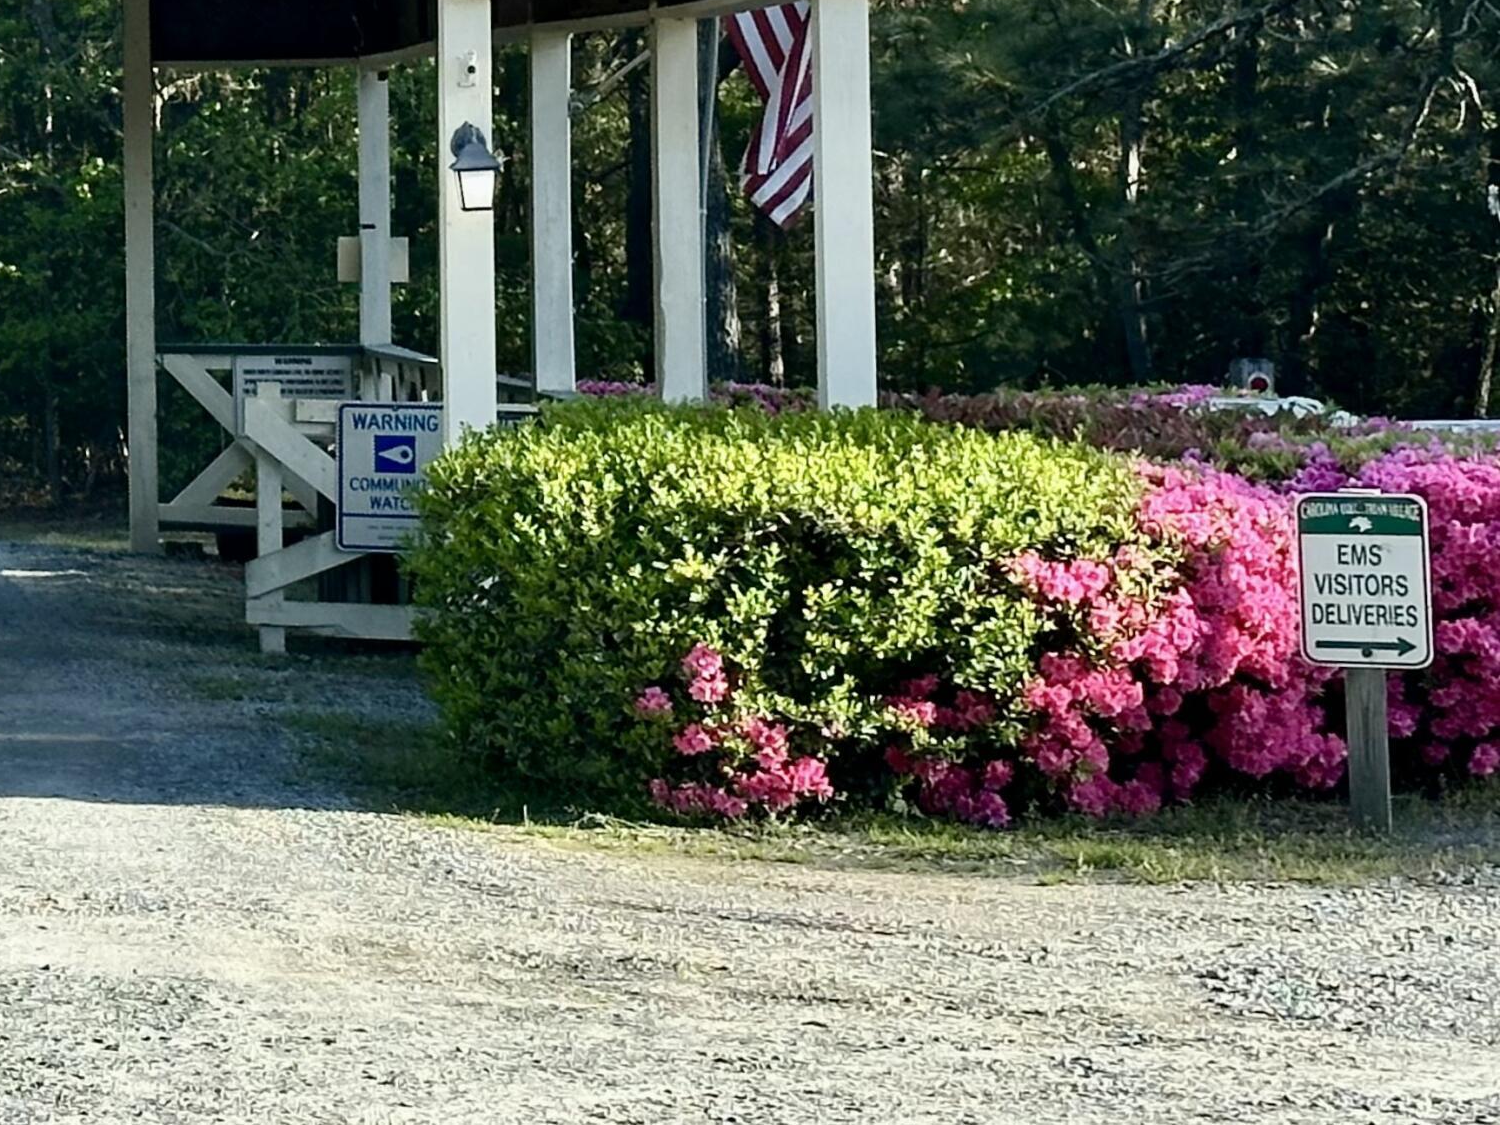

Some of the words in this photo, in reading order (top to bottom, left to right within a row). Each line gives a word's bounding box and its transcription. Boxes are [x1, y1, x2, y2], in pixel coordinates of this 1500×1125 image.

[352, 413, 439, 432] WARNING
[349, 477, 427, 492] COMMUNIT
[1337, 544, 1382, 566] EMS
[1314, 573, 1409, 597] VISITORS
[1311, 603, 1418, 628] DELIVERIES
